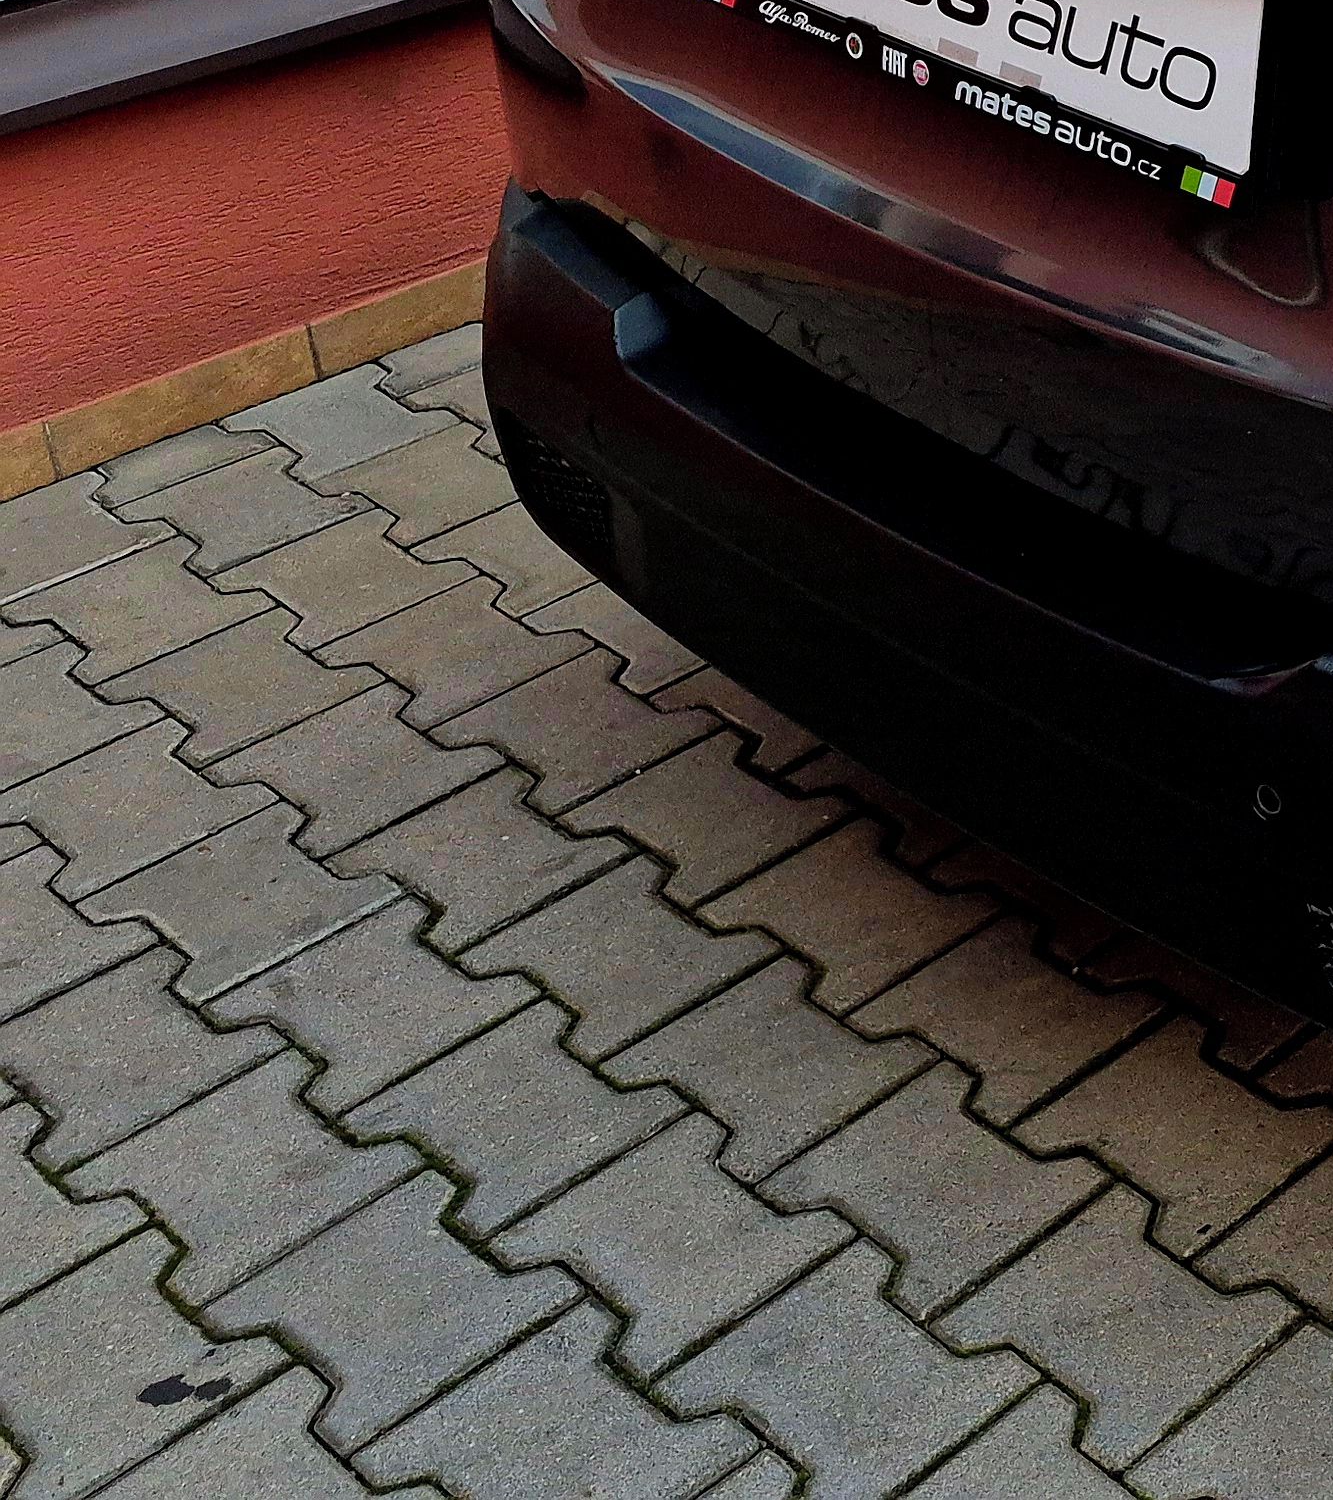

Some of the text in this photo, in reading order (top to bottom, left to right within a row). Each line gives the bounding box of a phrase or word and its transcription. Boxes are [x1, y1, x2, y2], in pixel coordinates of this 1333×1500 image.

[758, 0, 841, 44] Alfa Romeo
[881, 43, 909, 80] FIAT
